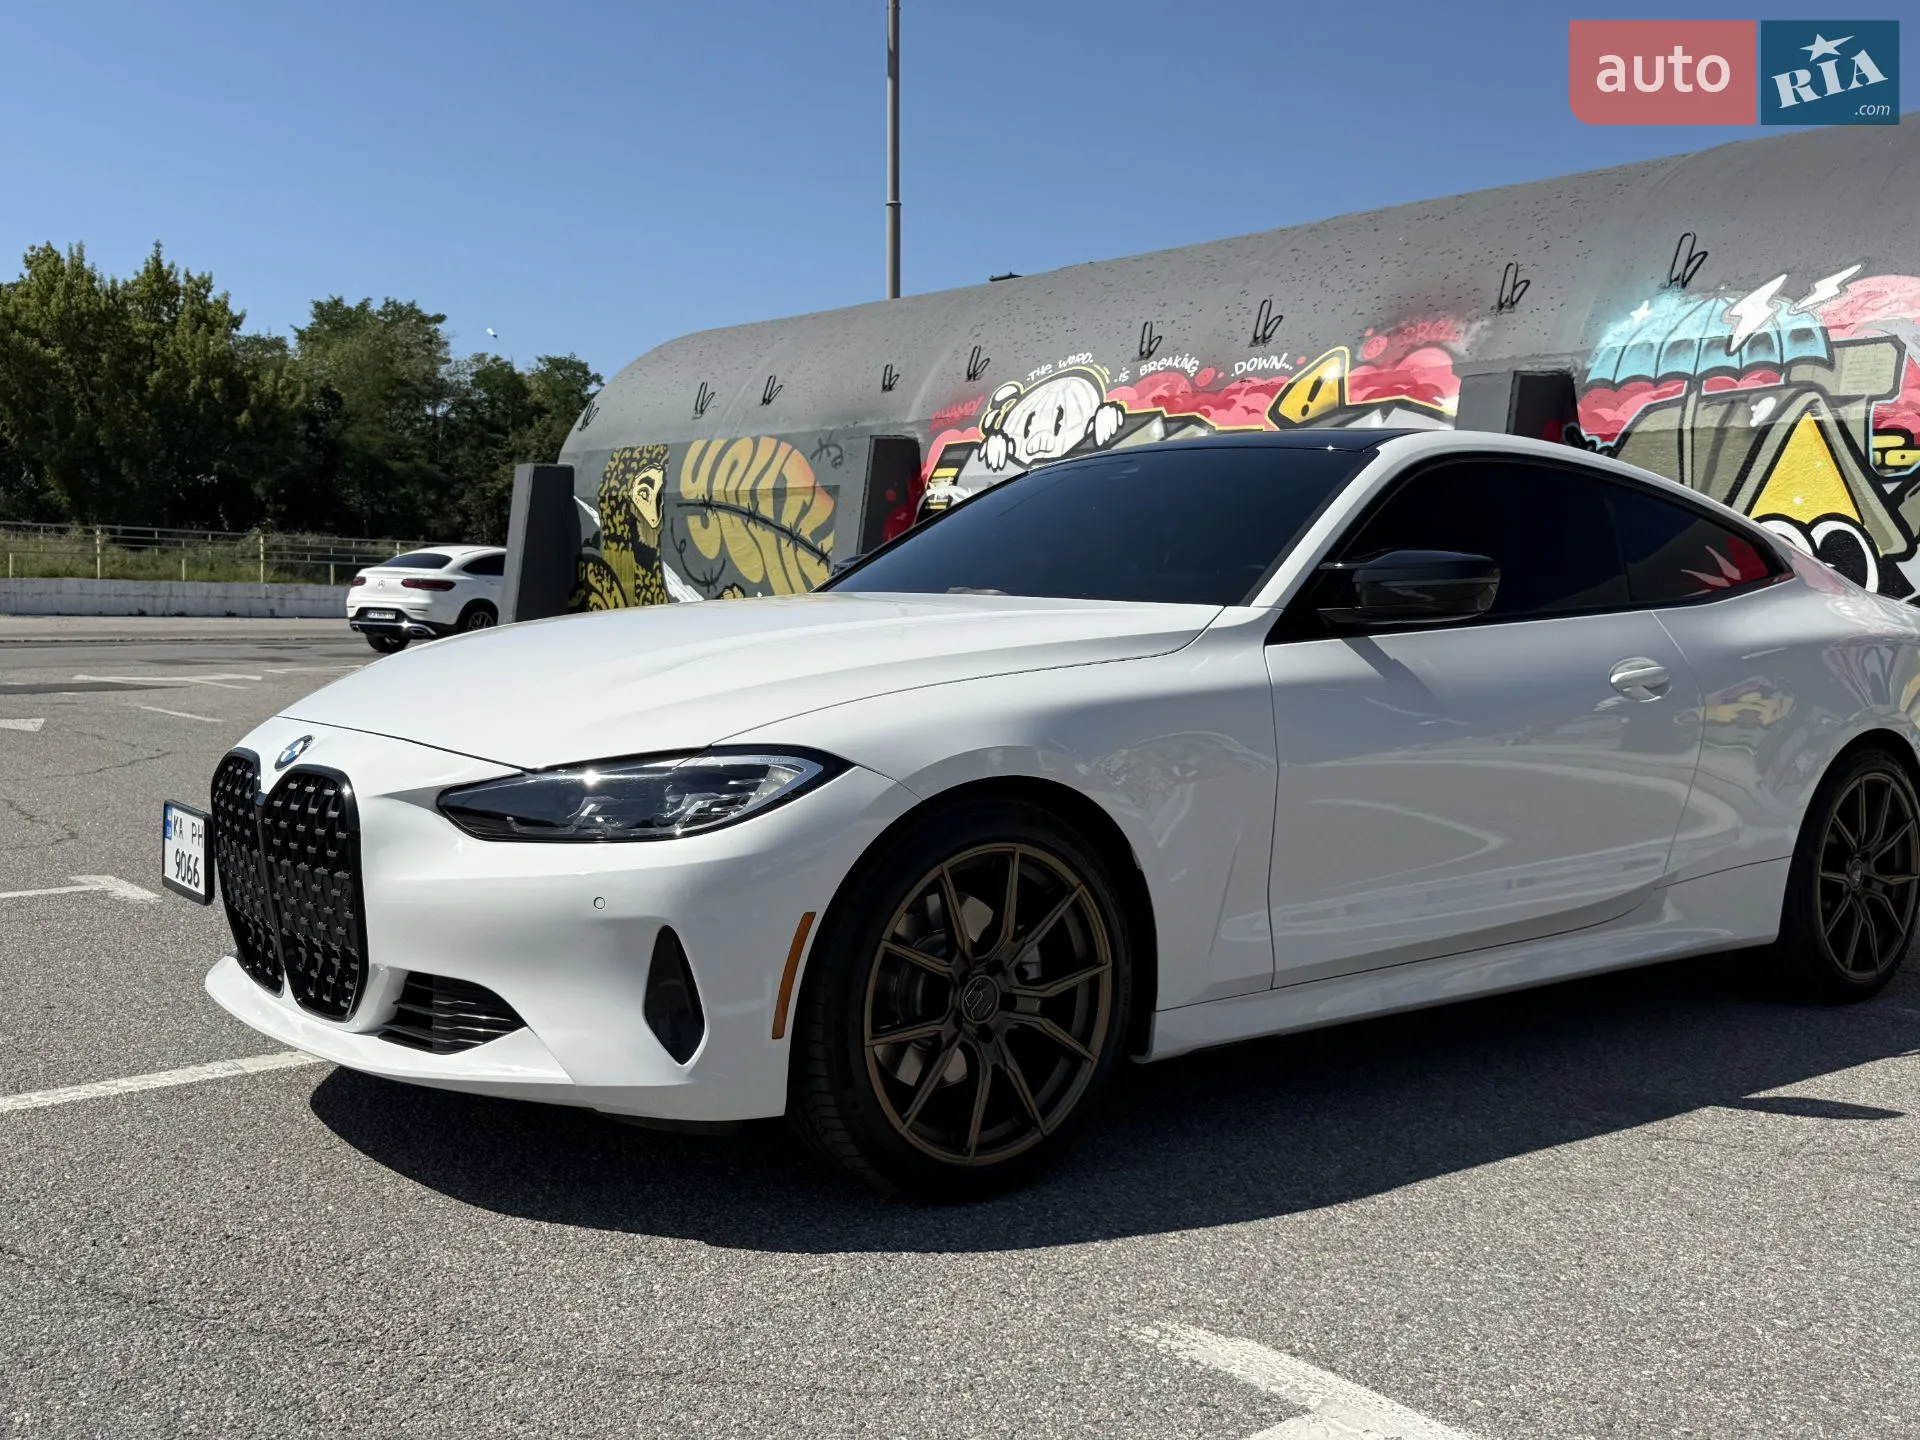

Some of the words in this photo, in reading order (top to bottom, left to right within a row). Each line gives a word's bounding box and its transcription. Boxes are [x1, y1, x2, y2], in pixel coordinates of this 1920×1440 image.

[173, 814, 184, 840] KA
[191, 821, 204, 848] PH
[175, 847, 200, 888] 9066
